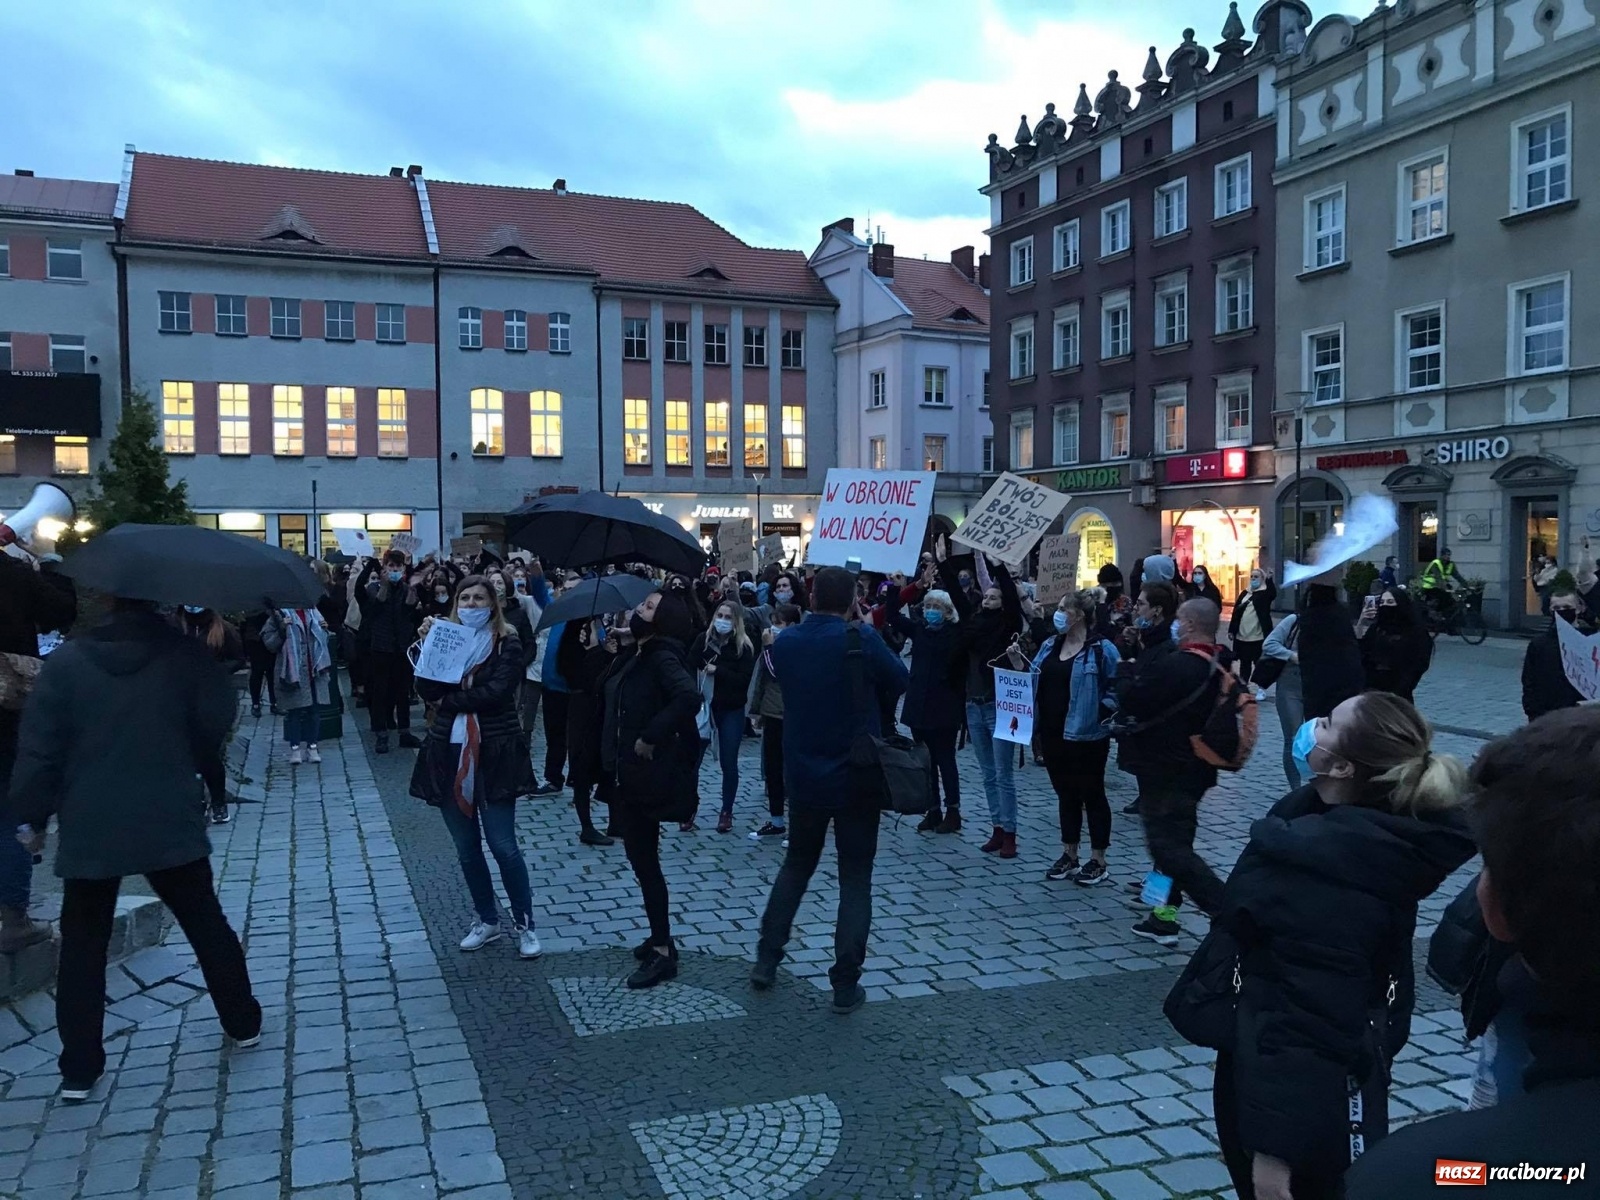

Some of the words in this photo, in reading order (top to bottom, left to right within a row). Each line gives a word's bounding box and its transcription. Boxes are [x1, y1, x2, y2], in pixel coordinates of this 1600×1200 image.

[1437, 436, 1510, 465] SHIRO
[1056, 467, 1121, 490] KANTOR
[826, 482, 840, 502] W
[845, 480, 921, 507] OBRONIE
[998, 478, 1048, 509] TWÓJ
[820, 510, 908, 545] WOLNOŚCI
[972, 513, 1029, 541] LEPSZY
[985, 497, 1020, 521] BÓL
[1018, 510, 1053, 531] JEST
[961, 526, 990, 544] NIŻ
[998, 675, 1029, 688] POLSKA
[1005, 689, 1023, 700] JEST
[996, 700, 1033, 719] KOBIETĄ
